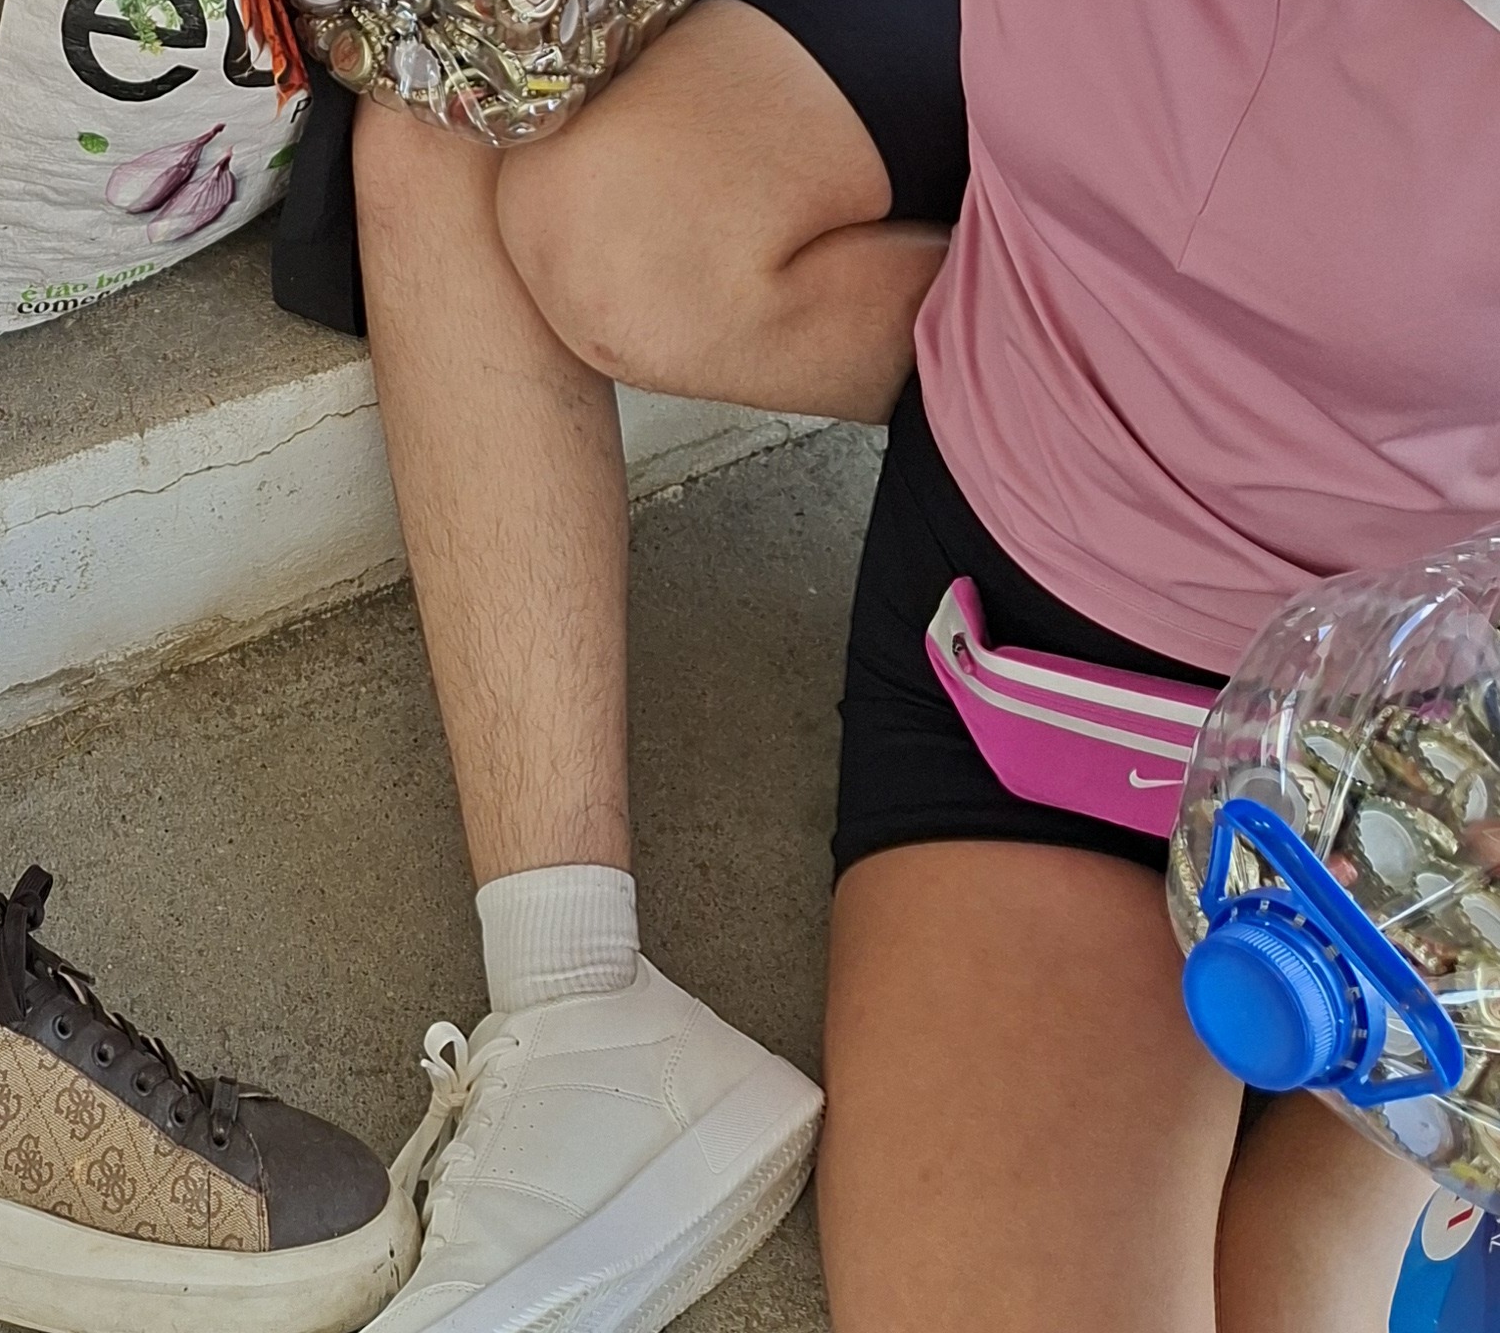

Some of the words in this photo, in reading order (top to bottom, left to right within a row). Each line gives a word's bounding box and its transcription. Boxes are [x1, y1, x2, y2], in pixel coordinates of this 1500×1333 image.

[45, 282, 89, 300] tão
[96, 261, 155, 290] bom
[16, 288, 112, 315] comer
